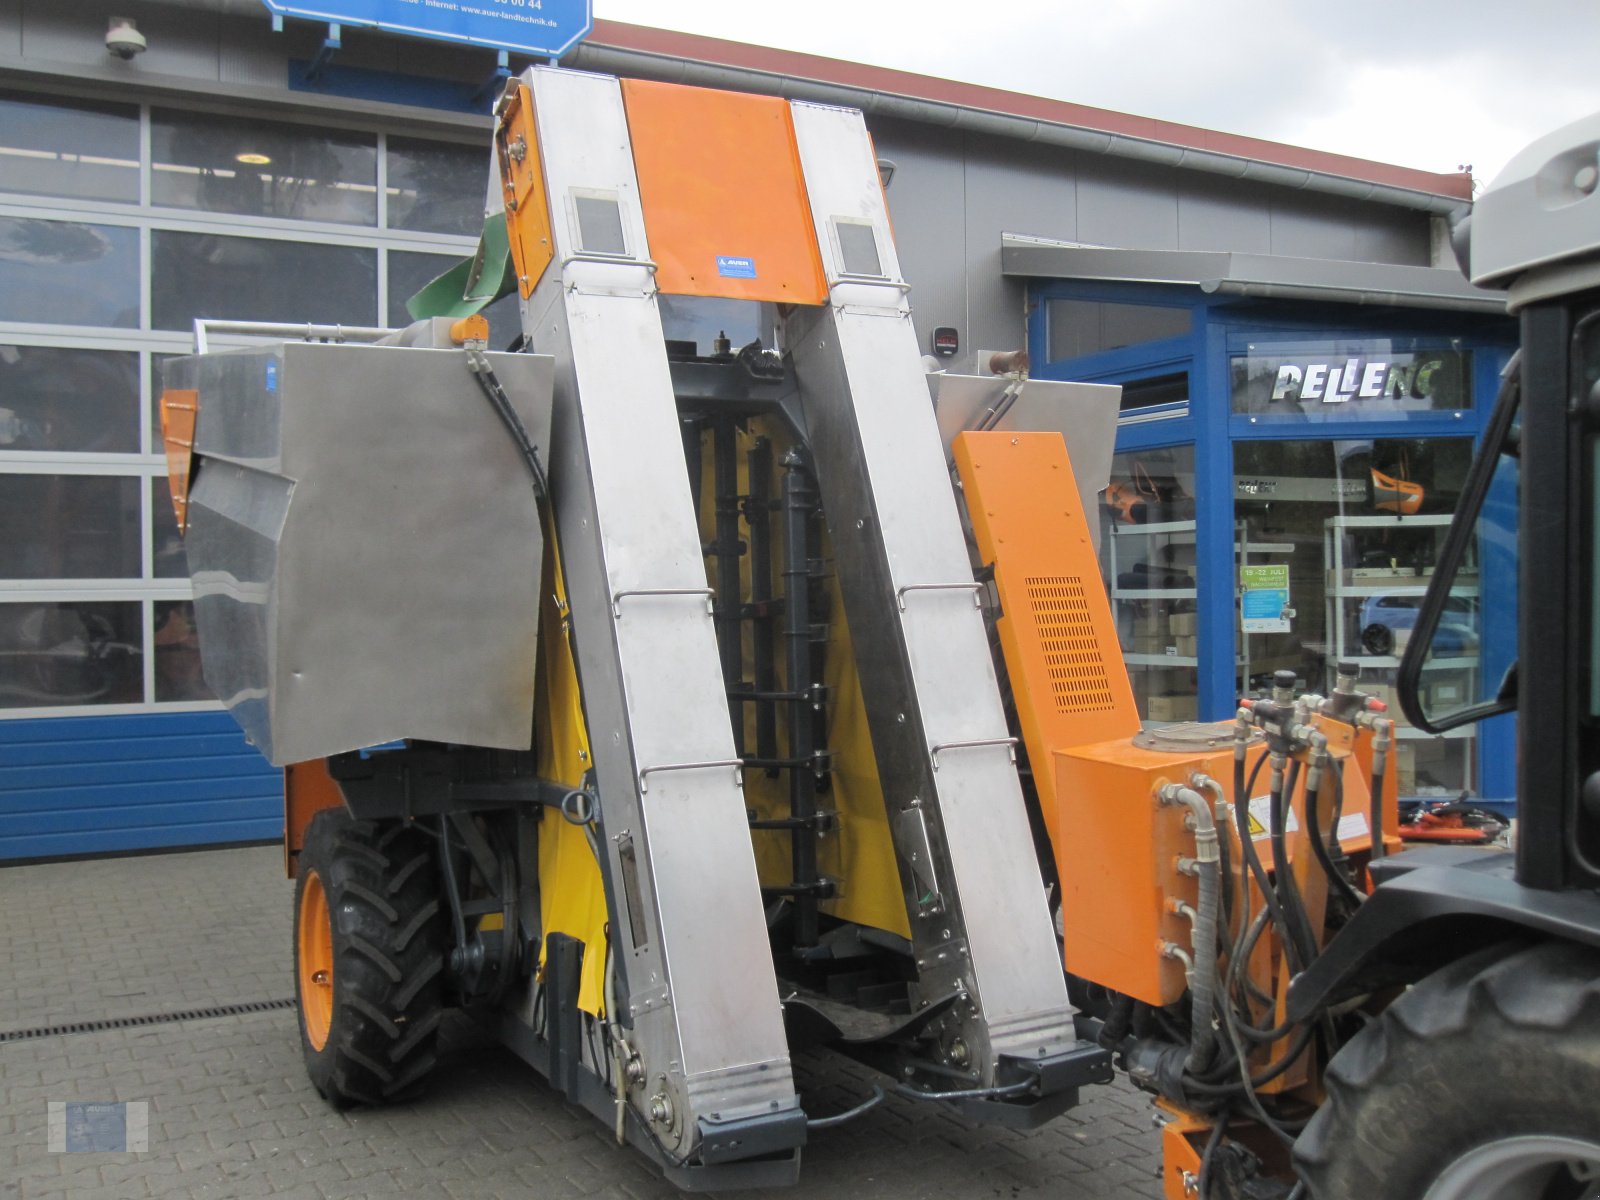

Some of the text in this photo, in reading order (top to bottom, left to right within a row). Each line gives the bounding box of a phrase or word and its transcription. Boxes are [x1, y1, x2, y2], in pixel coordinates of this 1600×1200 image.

[425, 0, 458, 11] Internet:
[461, 5, 557, 27] www.auer-landtechnik.de
[528, 0, 541, 10] 44
[1271, 358, 1442, 403] PELLENC
